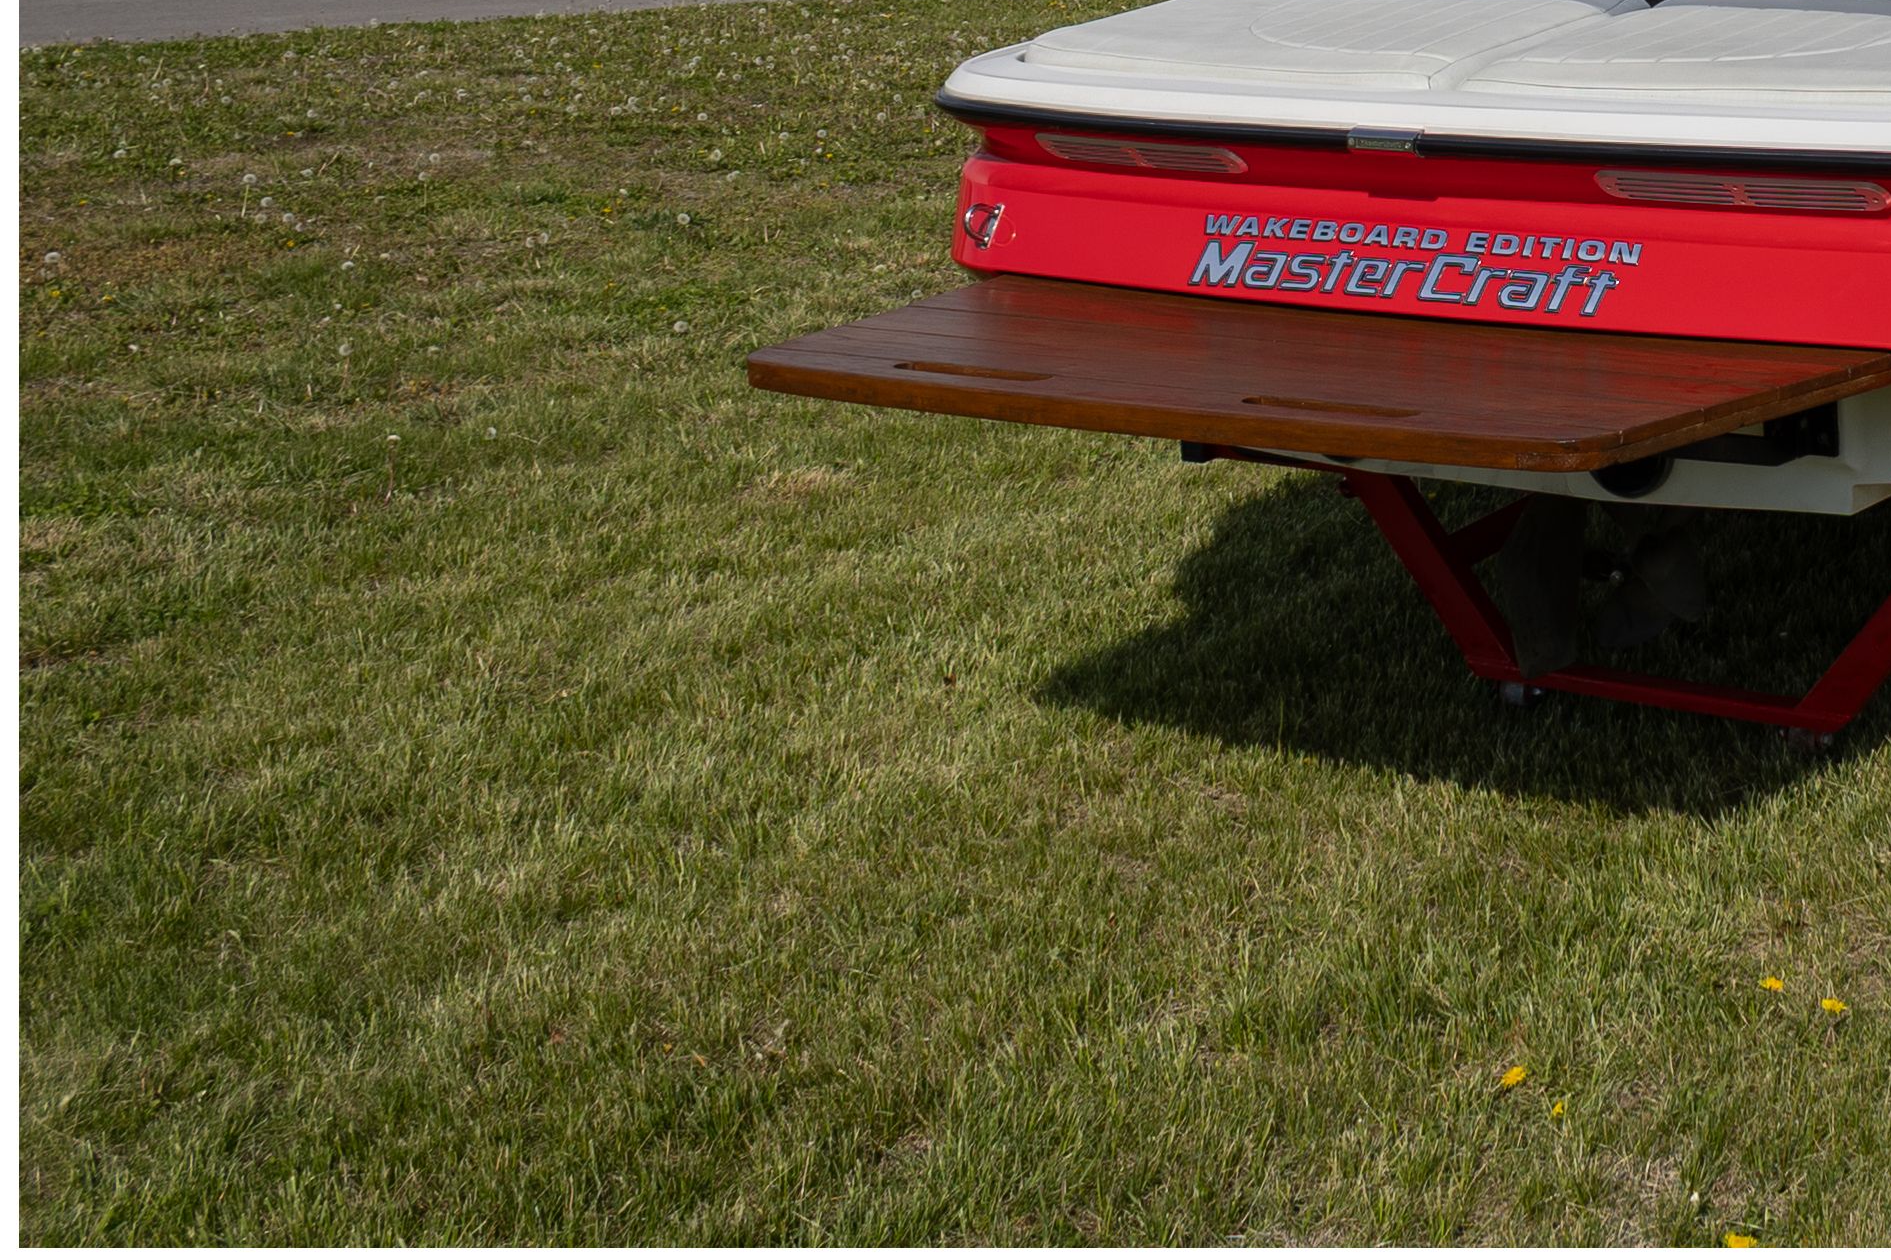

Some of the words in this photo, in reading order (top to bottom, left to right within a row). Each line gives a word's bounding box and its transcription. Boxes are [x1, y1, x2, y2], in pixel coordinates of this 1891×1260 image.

[1204, 213, 1449, 251] WAKEBOARD
[1465, 231, 1644, 266] EDITION
[1188, 240, 1620, 317] MasterCraft
